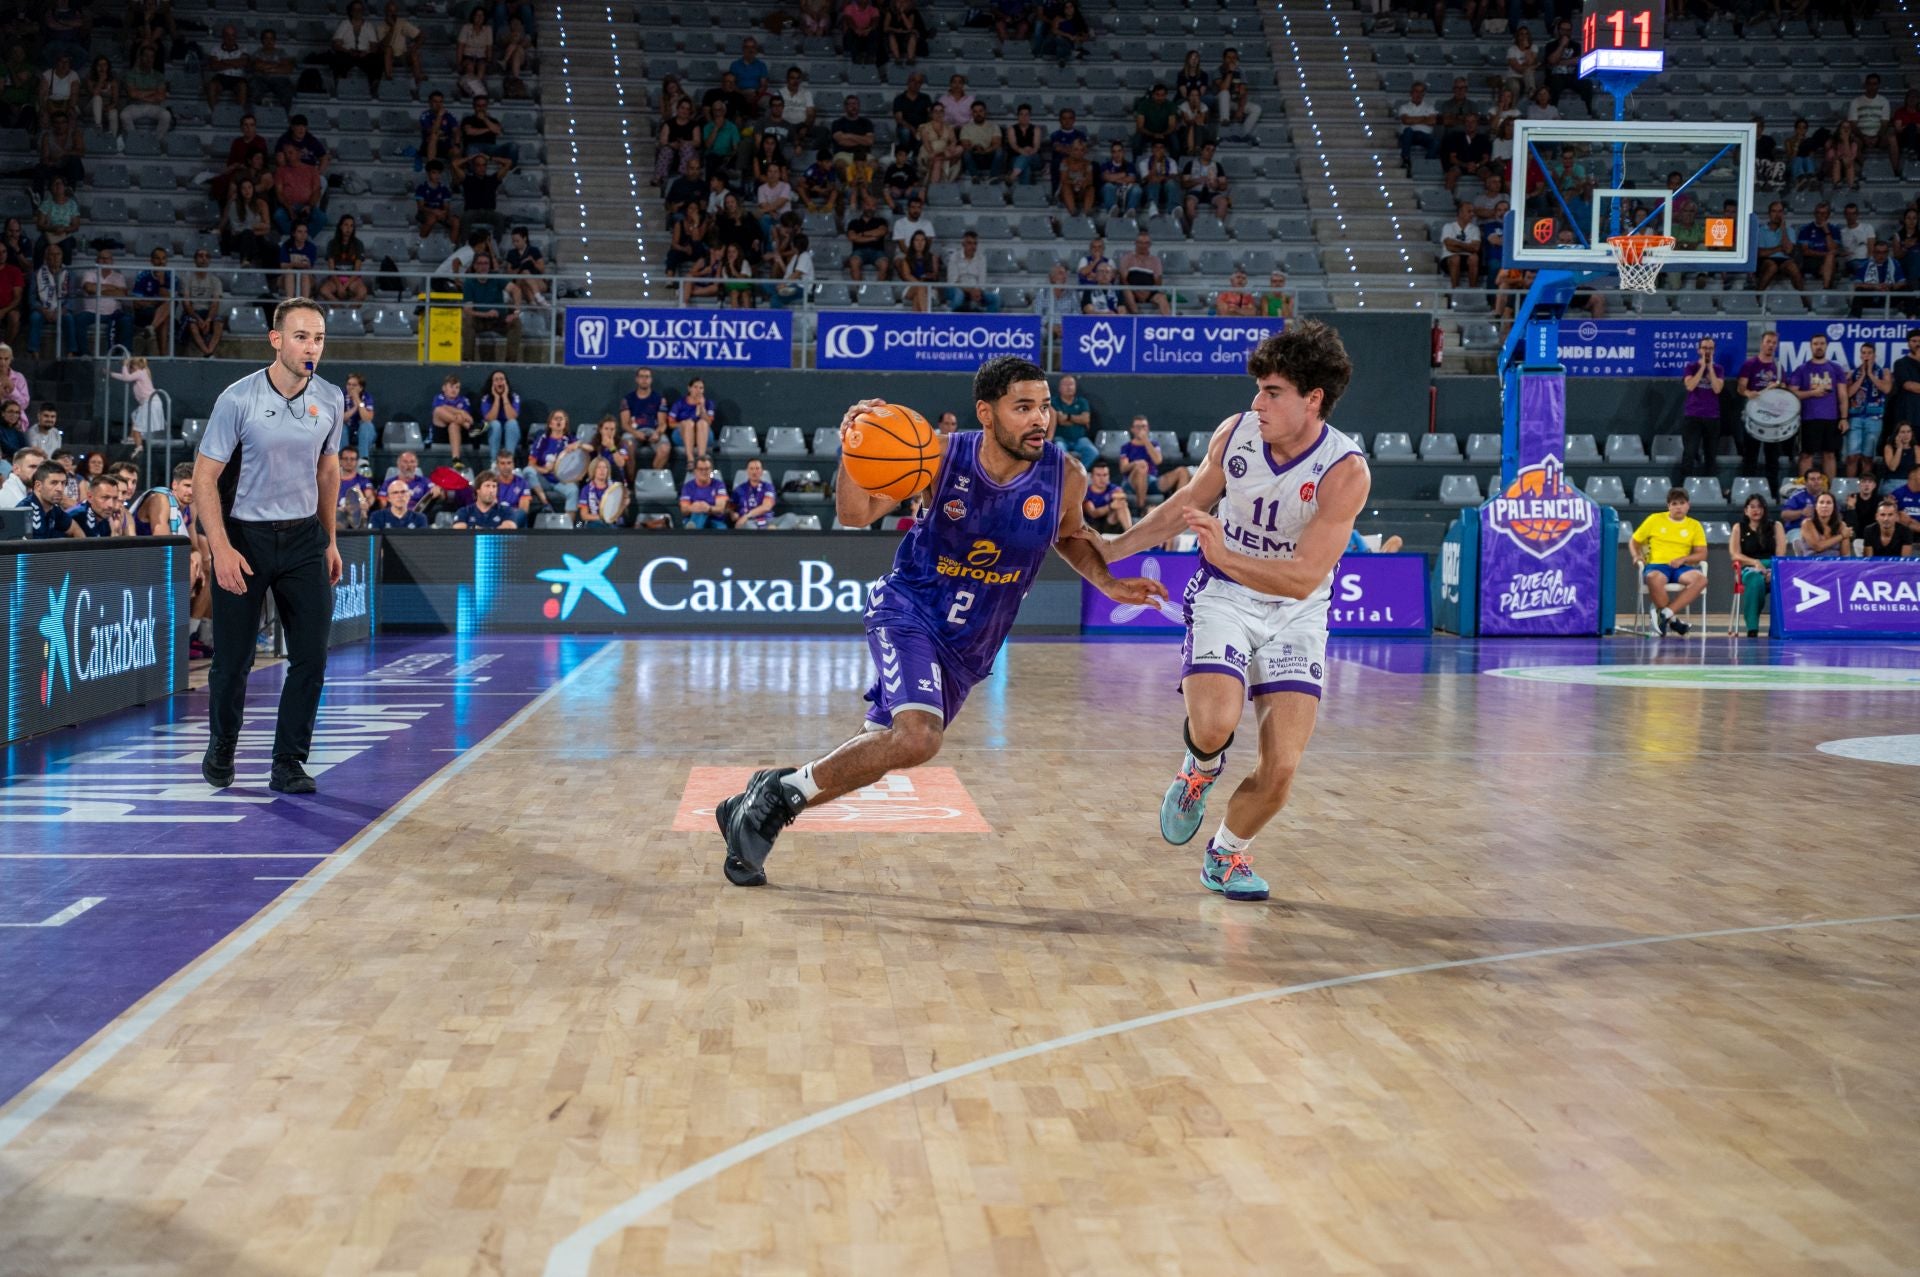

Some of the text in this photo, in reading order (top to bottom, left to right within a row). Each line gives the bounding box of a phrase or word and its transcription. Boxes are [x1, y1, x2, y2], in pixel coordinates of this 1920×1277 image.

[1606, 10, 1651, 48] 11
[614, 314, 783, 341] POLICLÍNICA
[884, 326, 1035, 350] patriciaOrdás
[1144, 327, 1270, 341] sara varas
[646, 340, 751, 361] DENTAL
[915, 351, 974, 360] PELUQUERÍA
[1557, 345, 1635, 359] ONDE DANI
[1571, 366, 1634, 374] TROBAR
[1252, 497, 1280, 532] 11
[1495, 498, 1586, 521] PALENCIA
[936, 561, 1021, 584] agropal
[1510, 568, 1564, 595] JUEGA
[332, 562, 366, 621] aixaBank
[1340, 573, 1363, 601] S
[1500, 585, 1577, 613] PALENCIA
[1850, 580, 1920, 602] ARA
[947, 590, 975, 625] 2
[1333, 606, 1393, 622] trial
[74, 585, 156, 681] CaixaBank
